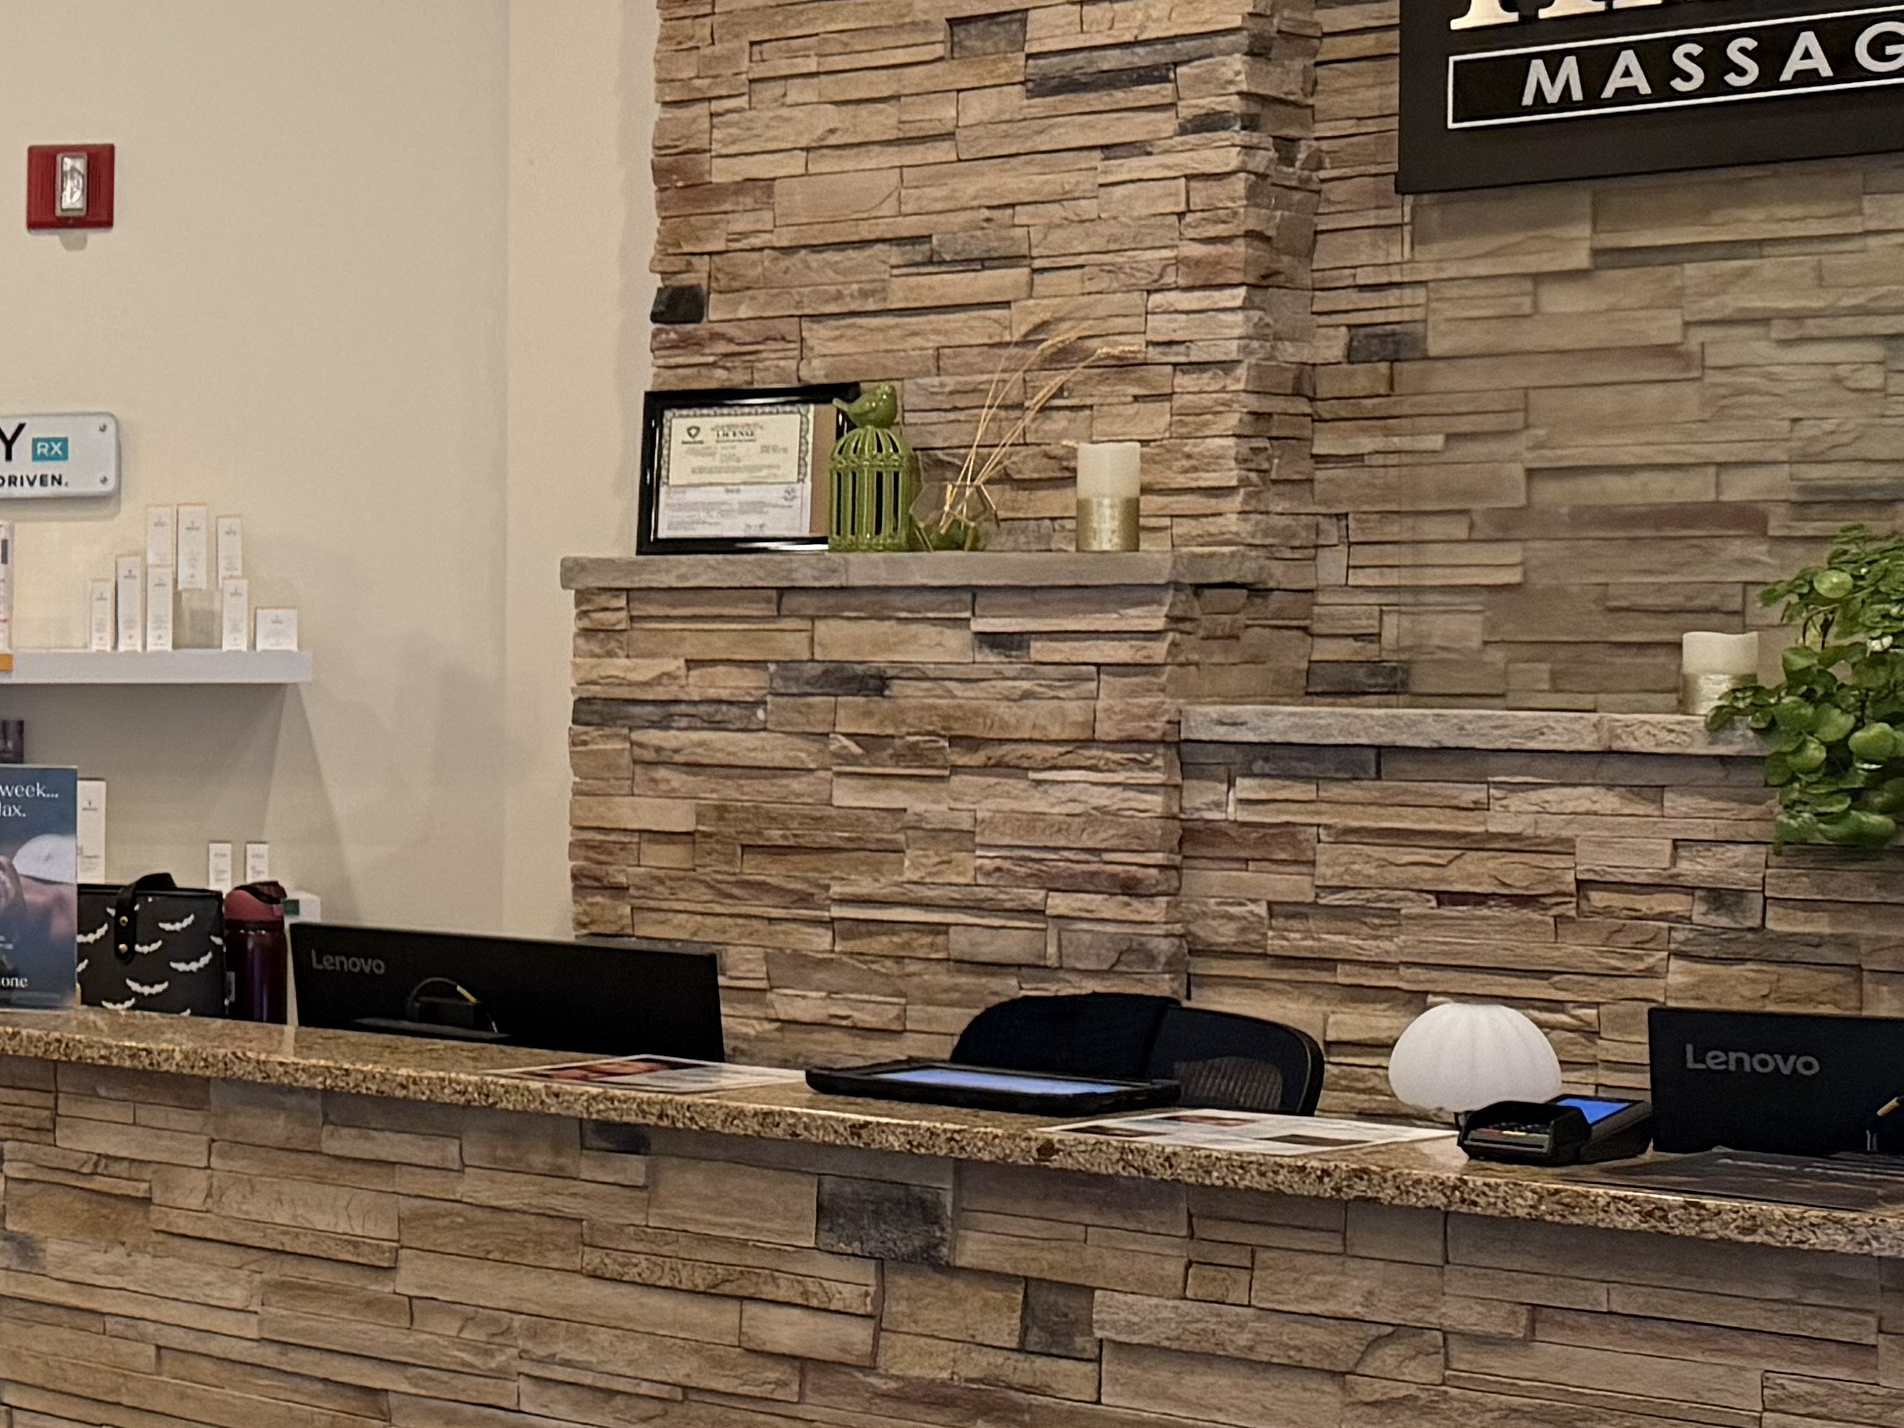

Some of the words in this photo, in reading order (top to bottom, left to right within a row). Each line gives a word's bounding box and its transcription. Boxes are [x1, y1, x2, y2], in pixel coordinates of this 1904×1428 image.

[36, 441, 64, 456] RX
[0, 781, 59, 799] week...
[311, 949, 385, 974] Lenovo
[1686, 1043, 1821, 1076] Lenovo
